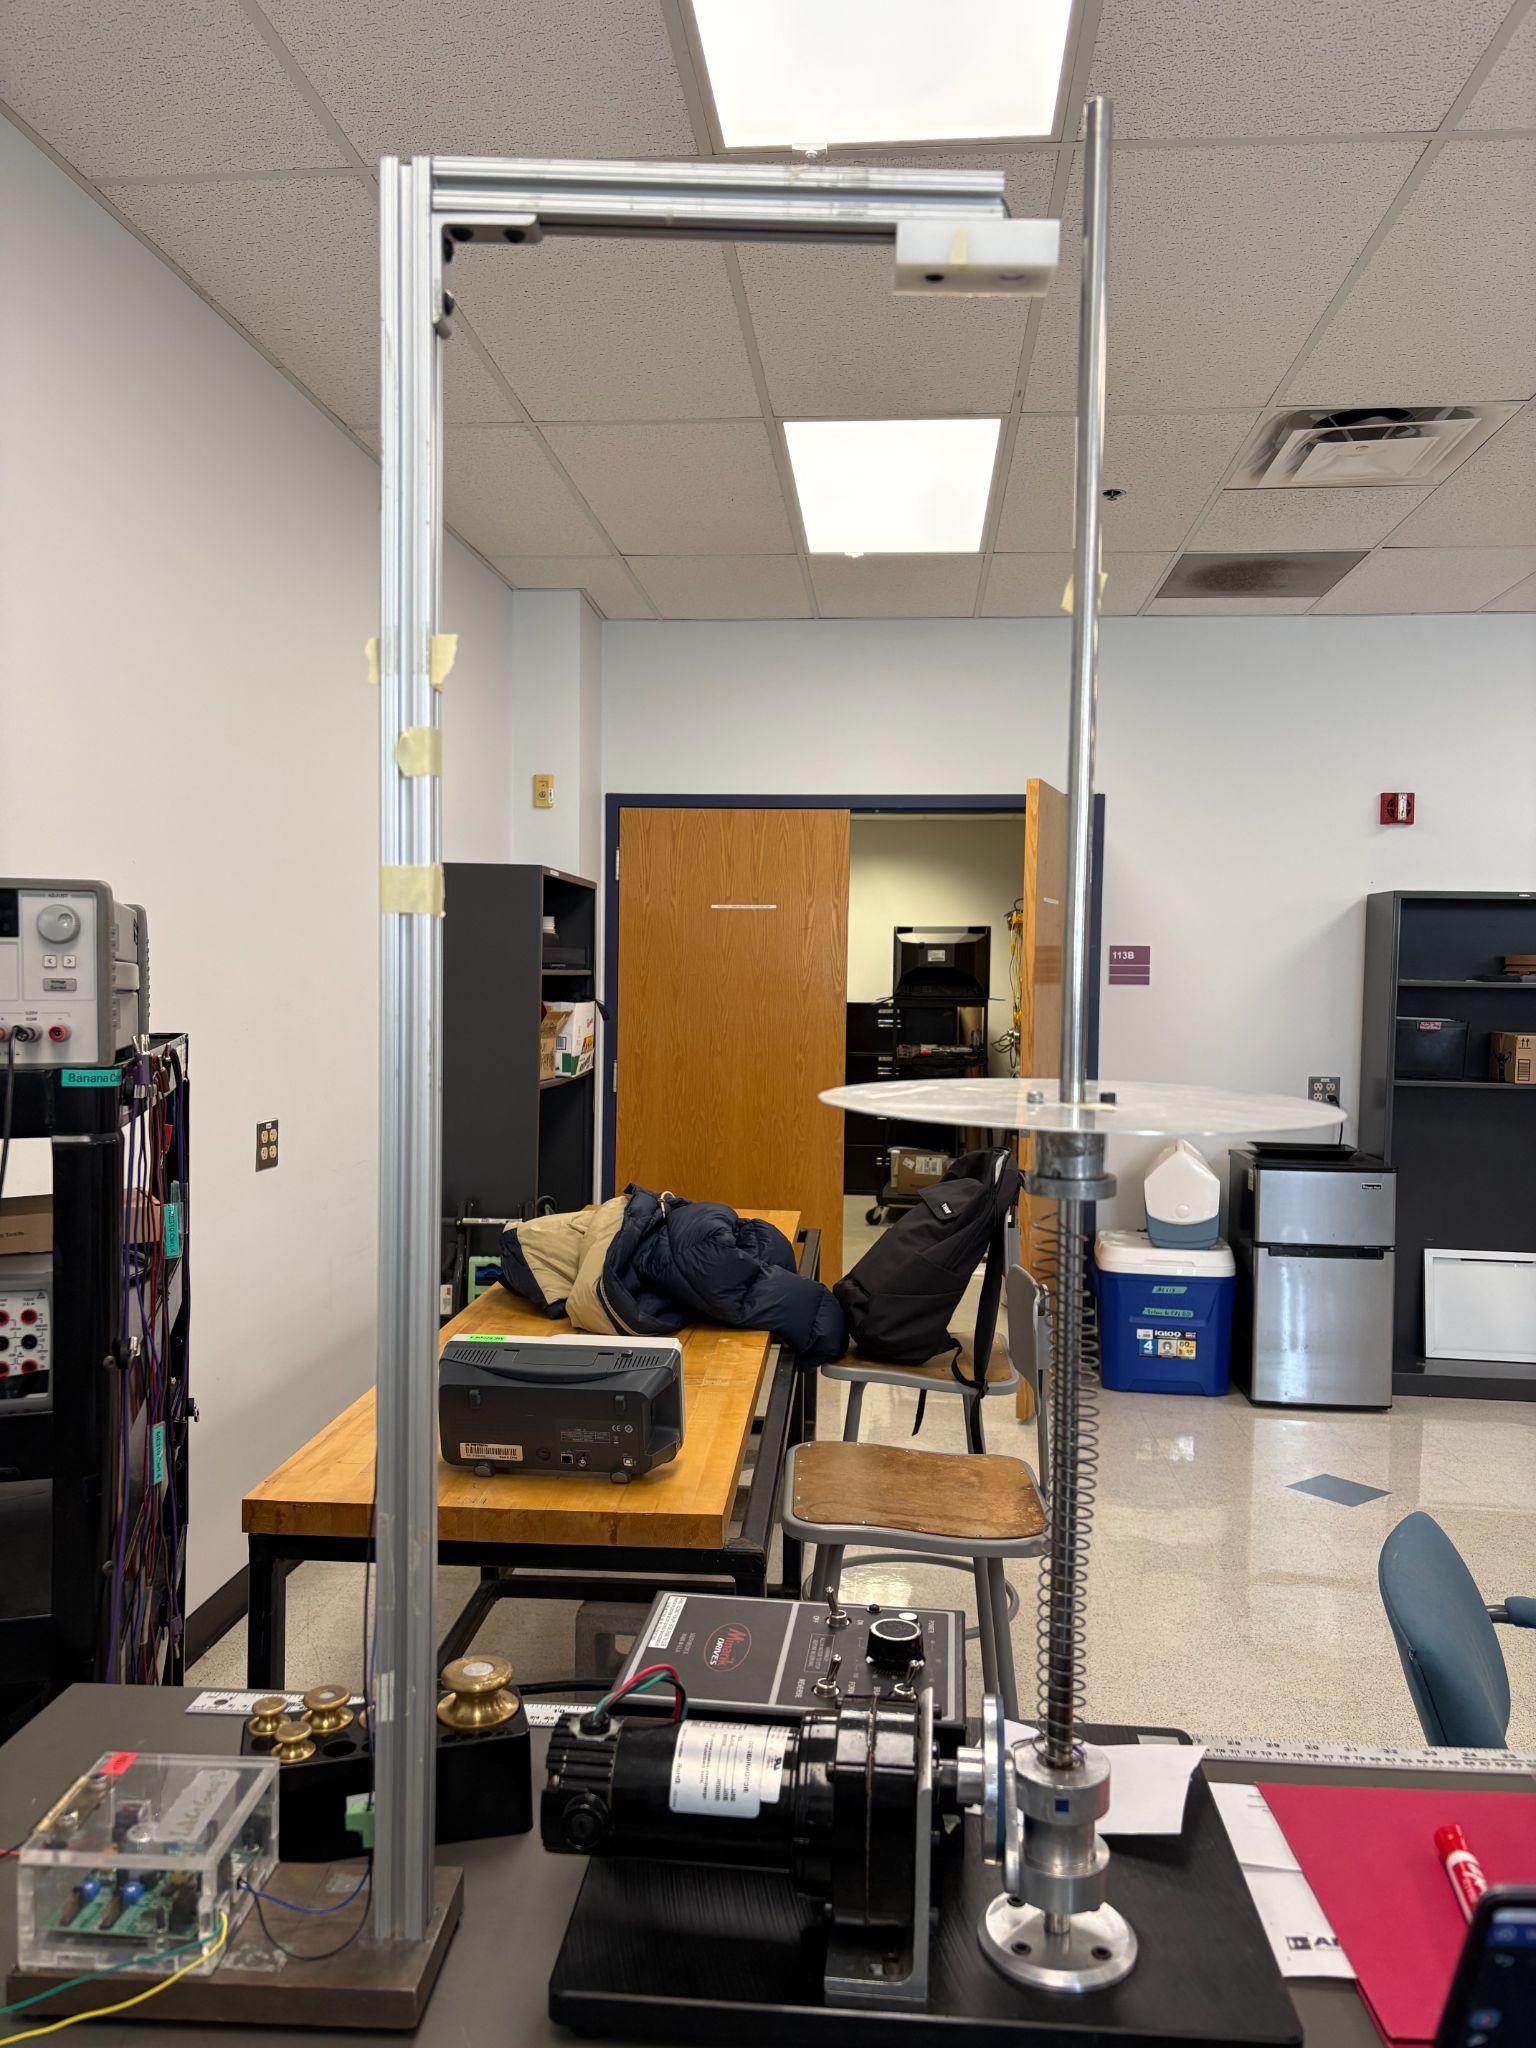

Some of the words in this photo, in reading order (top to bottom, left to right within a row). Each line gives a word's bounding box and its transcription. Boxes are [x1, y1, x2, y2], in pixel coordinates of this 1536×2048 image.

[1112, 951, 1135, 960] 113B
[68, 1073, 108, 1083] Banana
[110, 1073, 121, 1083] Ca
[1143, 1340, 1153, 1350] 4
[709, 1637, 725, 1666] DRIVES
[795, 1678, 806, 1699] REVERSE
[847, 1681, 856, 1694] FORW
